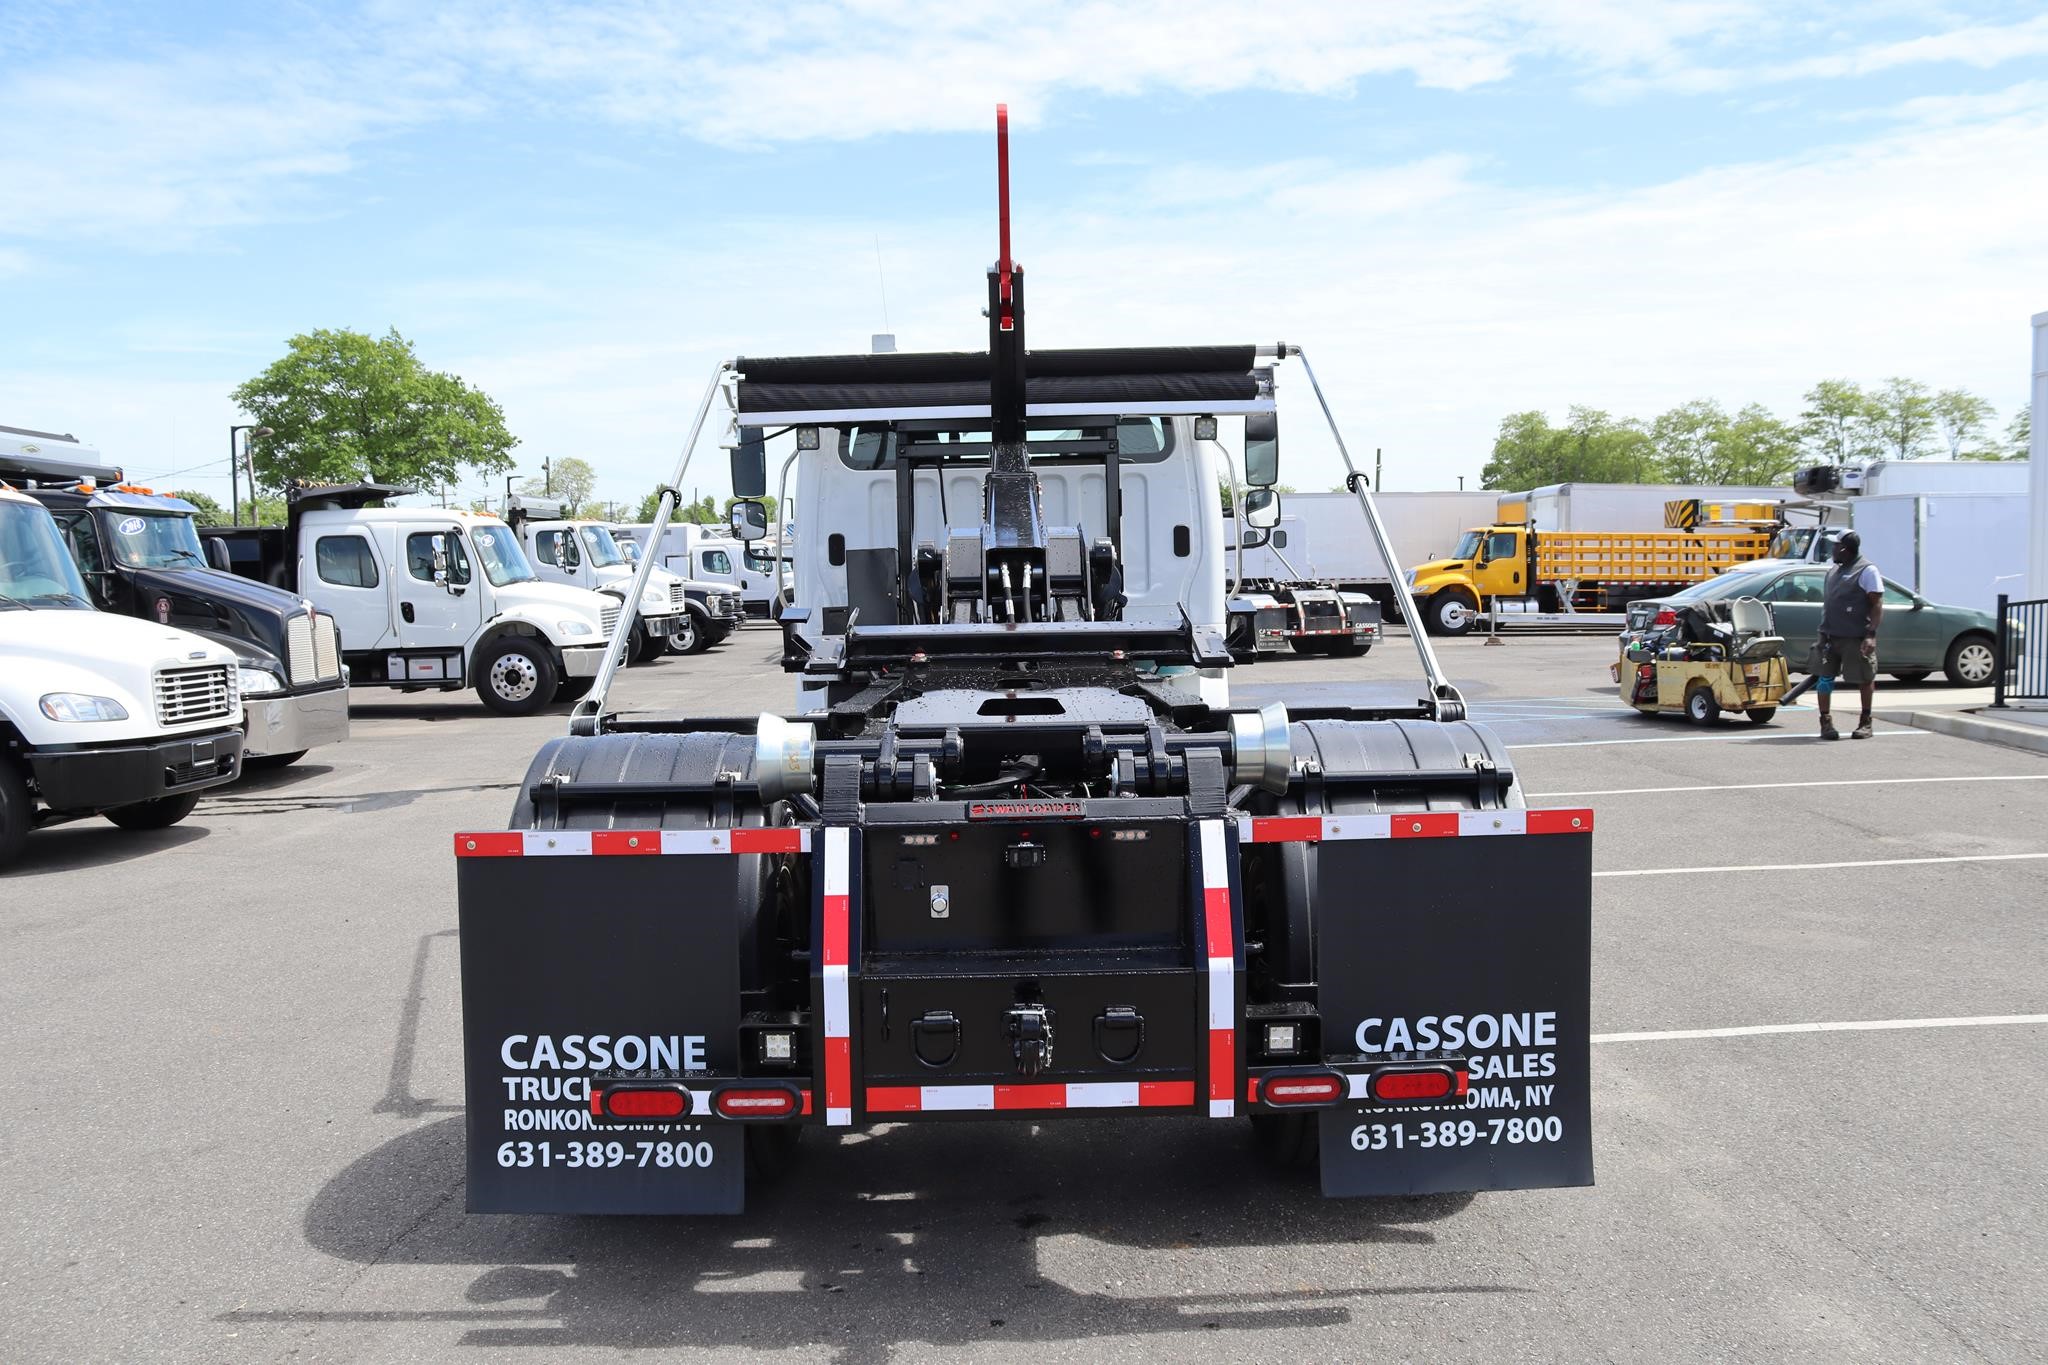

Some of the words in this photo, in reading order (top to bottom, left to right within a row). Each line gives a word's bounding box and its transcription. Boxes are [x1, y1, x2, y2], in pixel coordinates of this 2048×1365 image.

[1356, 1012, 1557, 1052] CASSONE
[501, 1035, 707, 1070] CASSONE
[1468, 1053, 1556, 1080] SALES
[1525, 1084, 1555, 1107] NY
[1351, 1116, 1563, 1151] 631-389-7800
[498, 1142, 714, 1168] 631-389-7800
